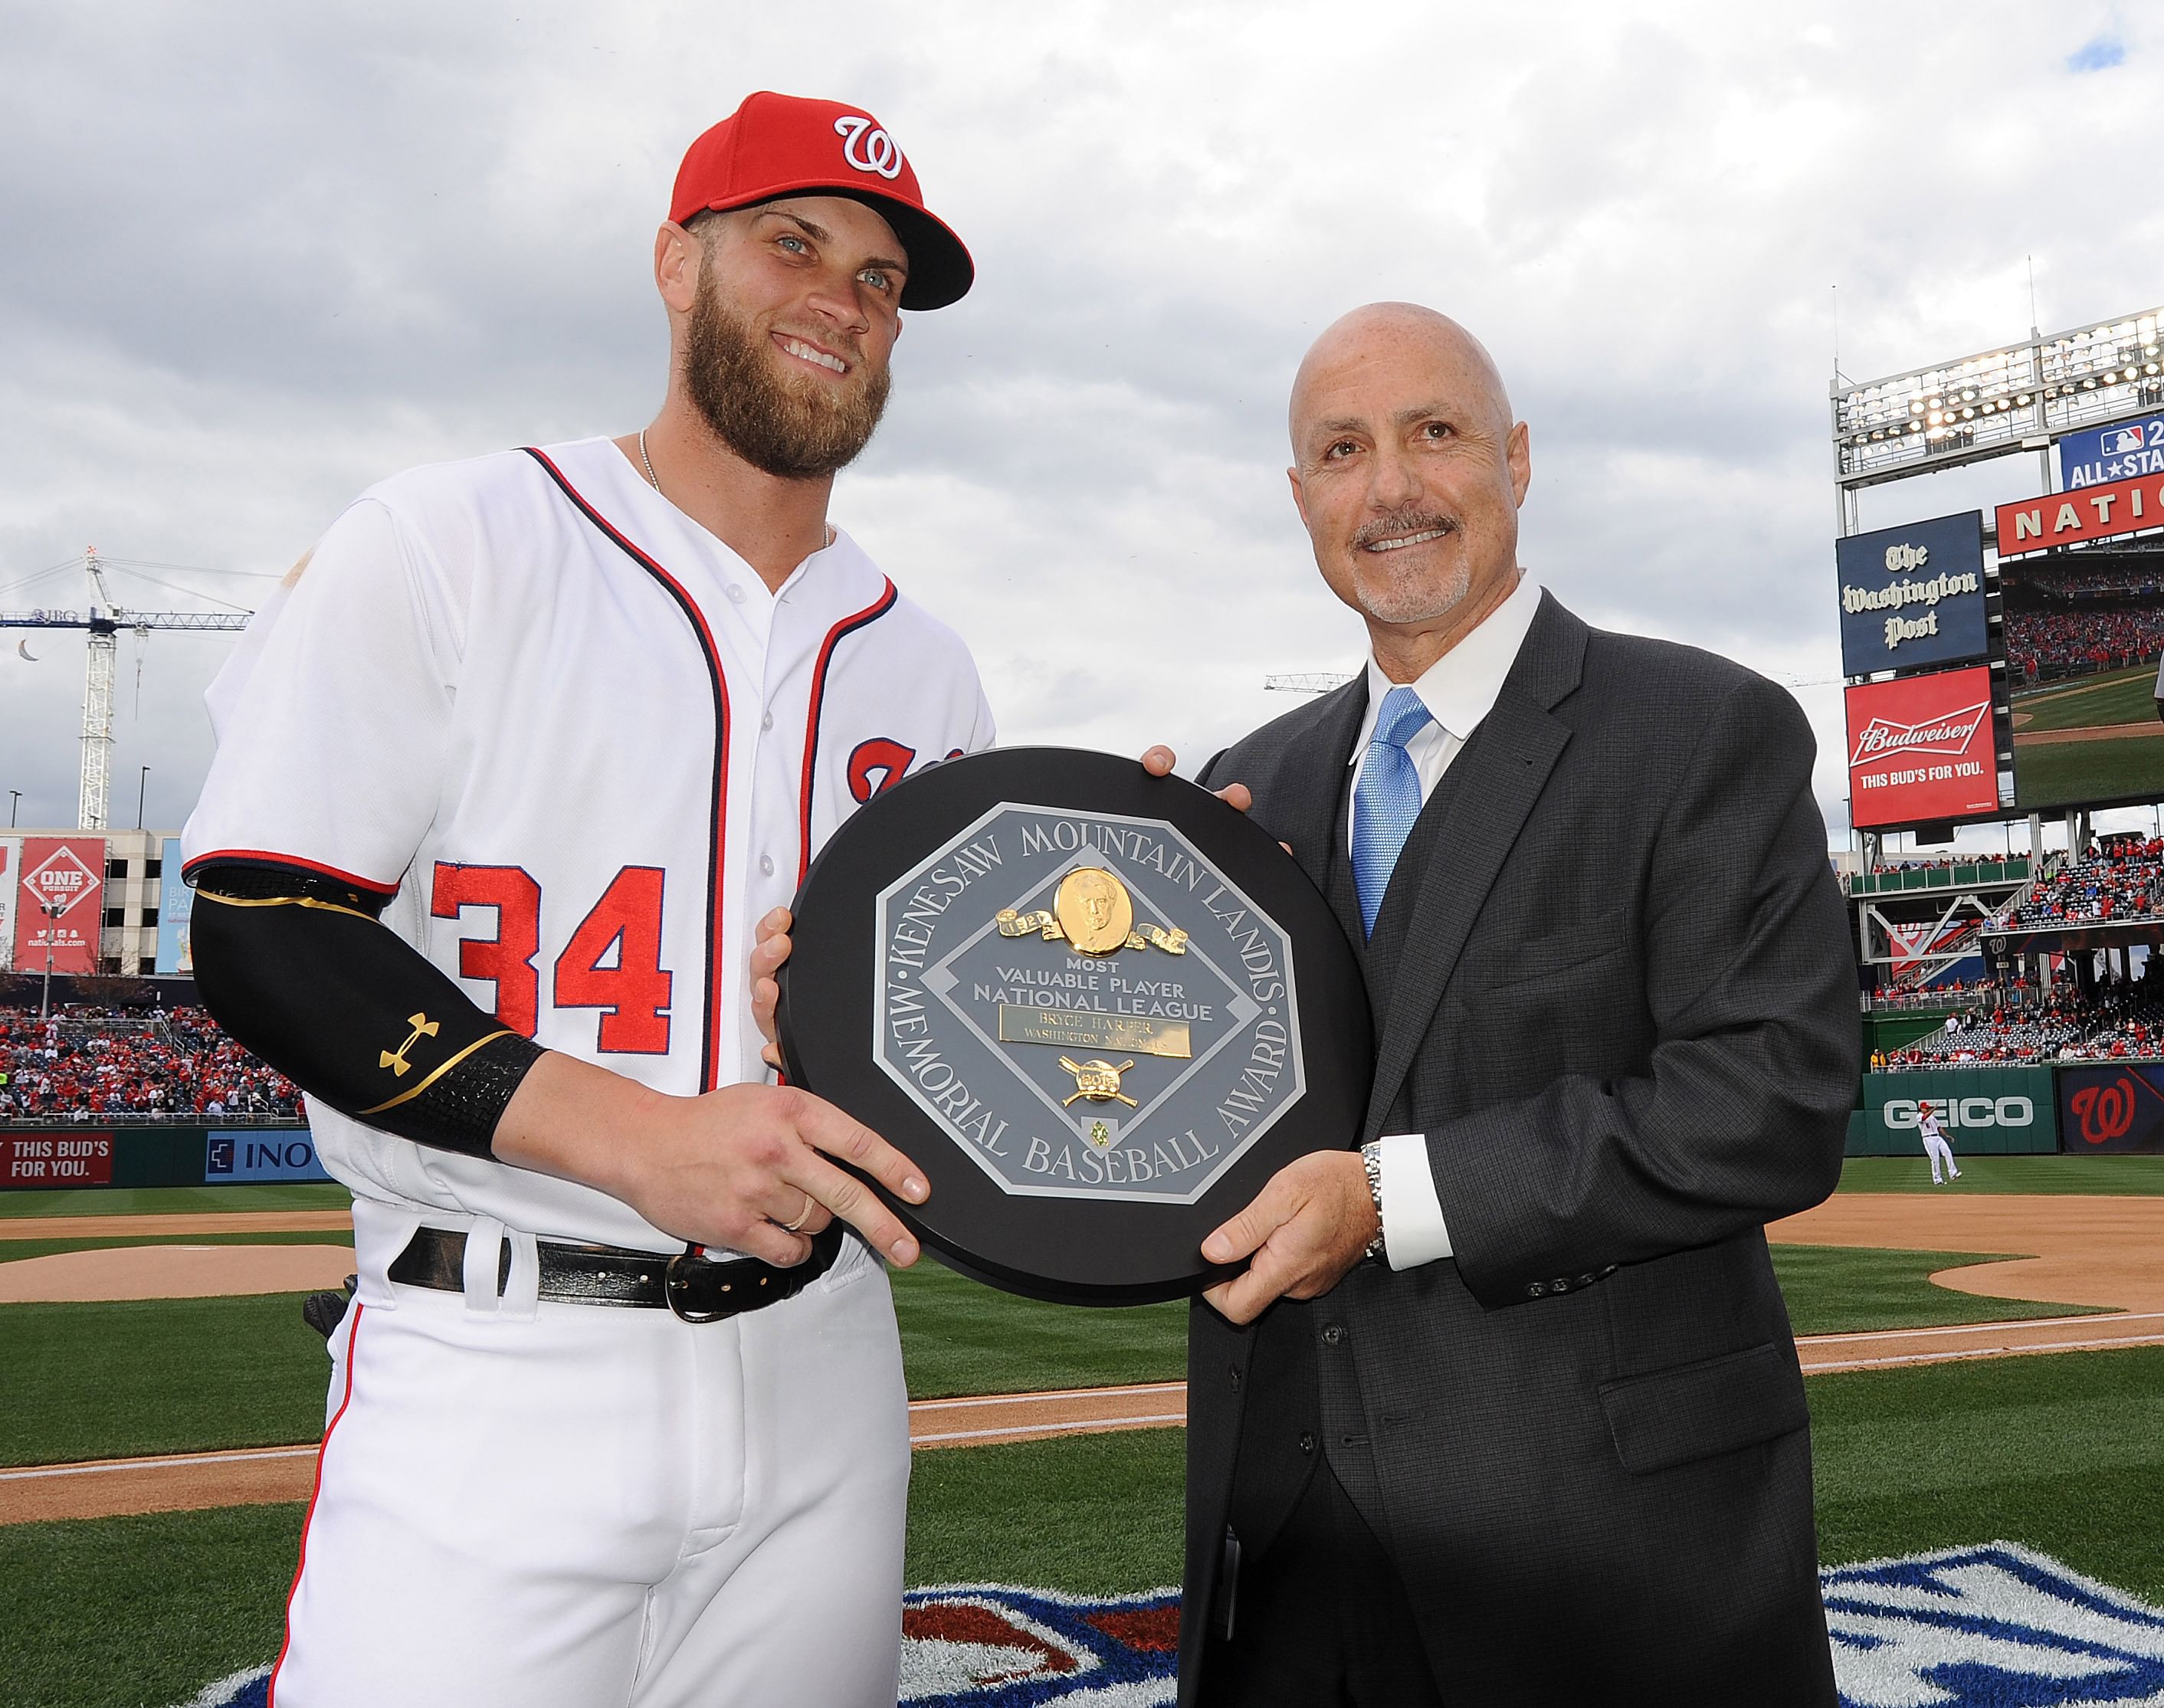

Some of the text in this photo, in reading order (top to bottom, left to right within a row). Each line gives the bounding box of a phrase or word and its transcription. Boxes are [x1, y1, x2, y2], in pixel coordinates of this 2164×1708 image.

[834, 116, 903, 179] W
[2071, 461, 2108, 489] ALL
[2015, 485, 2164, 540] NATI
[1886, 543, 1928, 572] The
[1843, 572, 1979, 614] Washington
[1885, 610, 1939, 650] Post
[1860, 722, 1975, 752] Budweiser
[1861, 761, 1984, 789] THIS BUD'S FOR YOU.
[41, 870, 83, 885] ONE
[889, 821, 1285, 1002] KENESAW MOUNTAIN LANDIS
[431, 860, 671, 1055] 34
[1066, 958, 1120, 974] MOST
[996, 966, 1185, 999] VALUABLE PLAYER
[974, 983, 1213, 1021] NATIONAL LEAGUE
[1024, 1028, 1098, 1044] WASHINGTON
[1039, 1012, 1153, 1034] BRYCE HARPER
[887, 982, 1288, 1184] MEMORIAL BASEBALL AWARD
[1884, 1096, 2034, 1129] GEICO
[2071, 1078, 2136, 1144] W
[12, 1141, 53, 1157] THIS
[57, 1140, 109, 1157] BUD'S
[245, 1142, 312, 1168] INO
[11, 1160, 90, 1177] FOR YOU.
